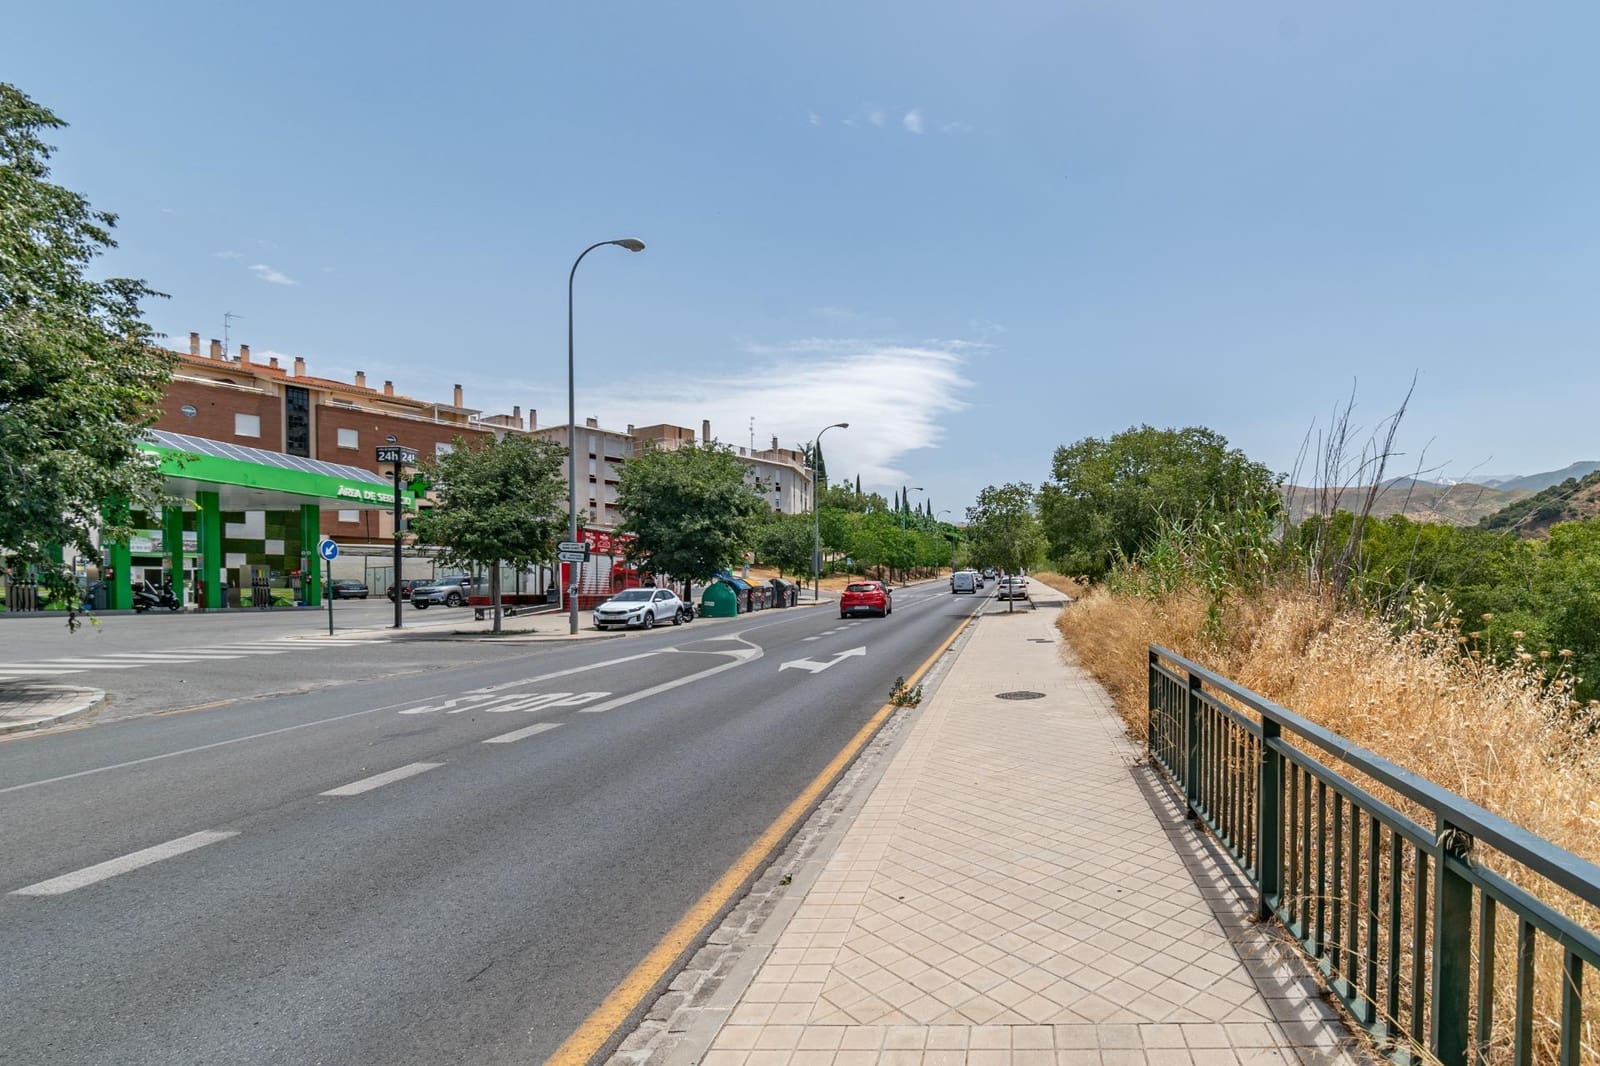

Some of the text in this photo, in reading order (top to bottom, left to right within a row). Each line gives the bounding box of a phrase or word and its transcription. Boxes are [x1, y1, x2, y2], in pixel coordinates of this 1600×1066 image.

[378, 451, 399, 461] 24h
[363, 490, 377, 501] DE
[398, 691, 612, 714] STOP
